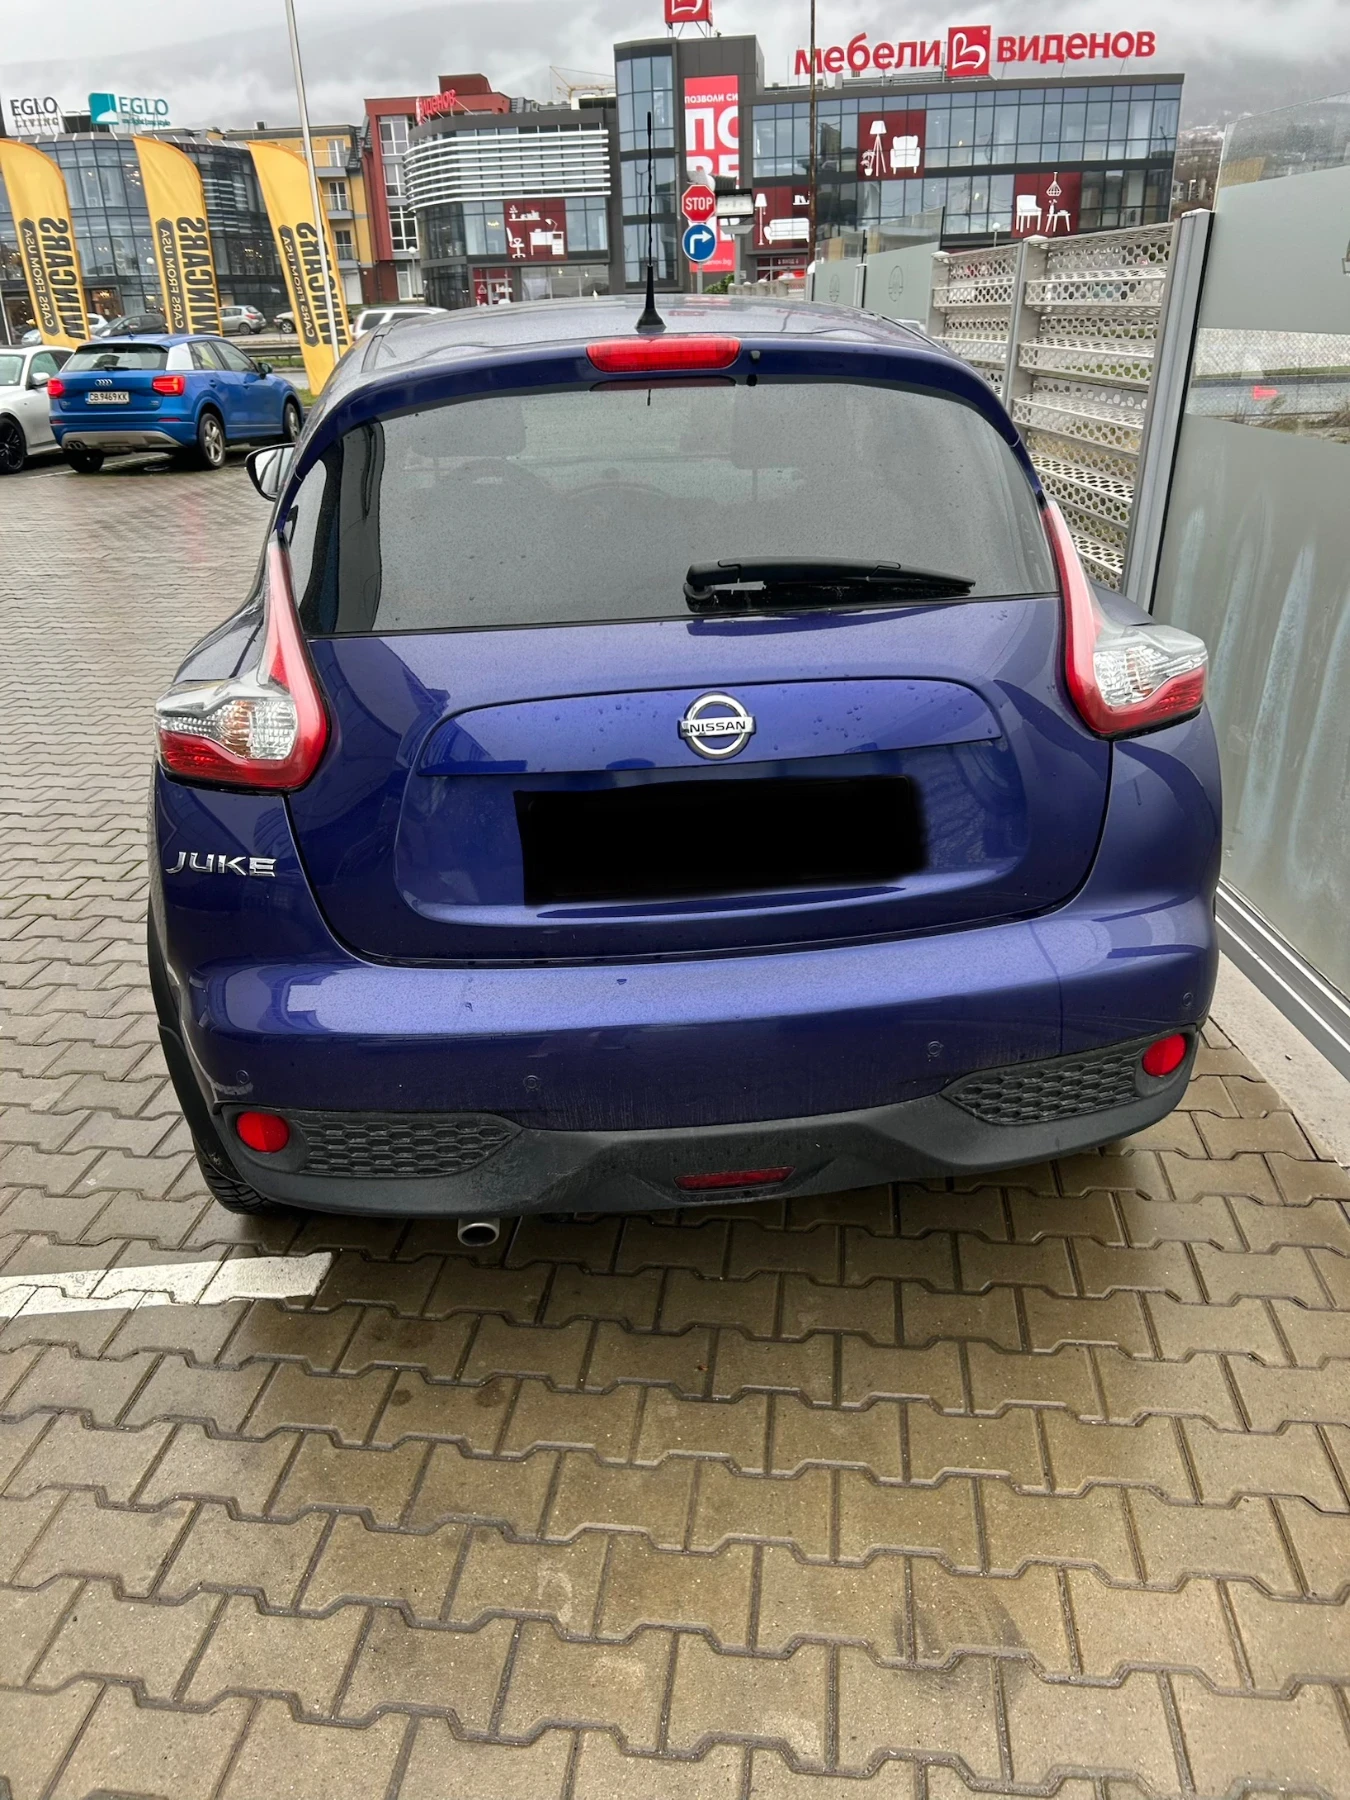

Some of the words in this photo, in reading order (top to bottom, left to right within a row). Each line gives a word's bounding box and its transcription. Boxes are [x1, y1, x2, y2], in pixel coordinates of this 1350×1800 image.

[685, 94, 724, 104] ПОЗВОЛИ
[726, 93, 738, 101] СИ
[10, 97, 58, 116] EGLO
[118, 96, 169, 116] EGLO
[14, 117, 59, 128] LIVING
[685, 197, 713, 211] STOP
[690, 720, 746, 733] NISSAN
[165, 851, 277, 878] JUKE
